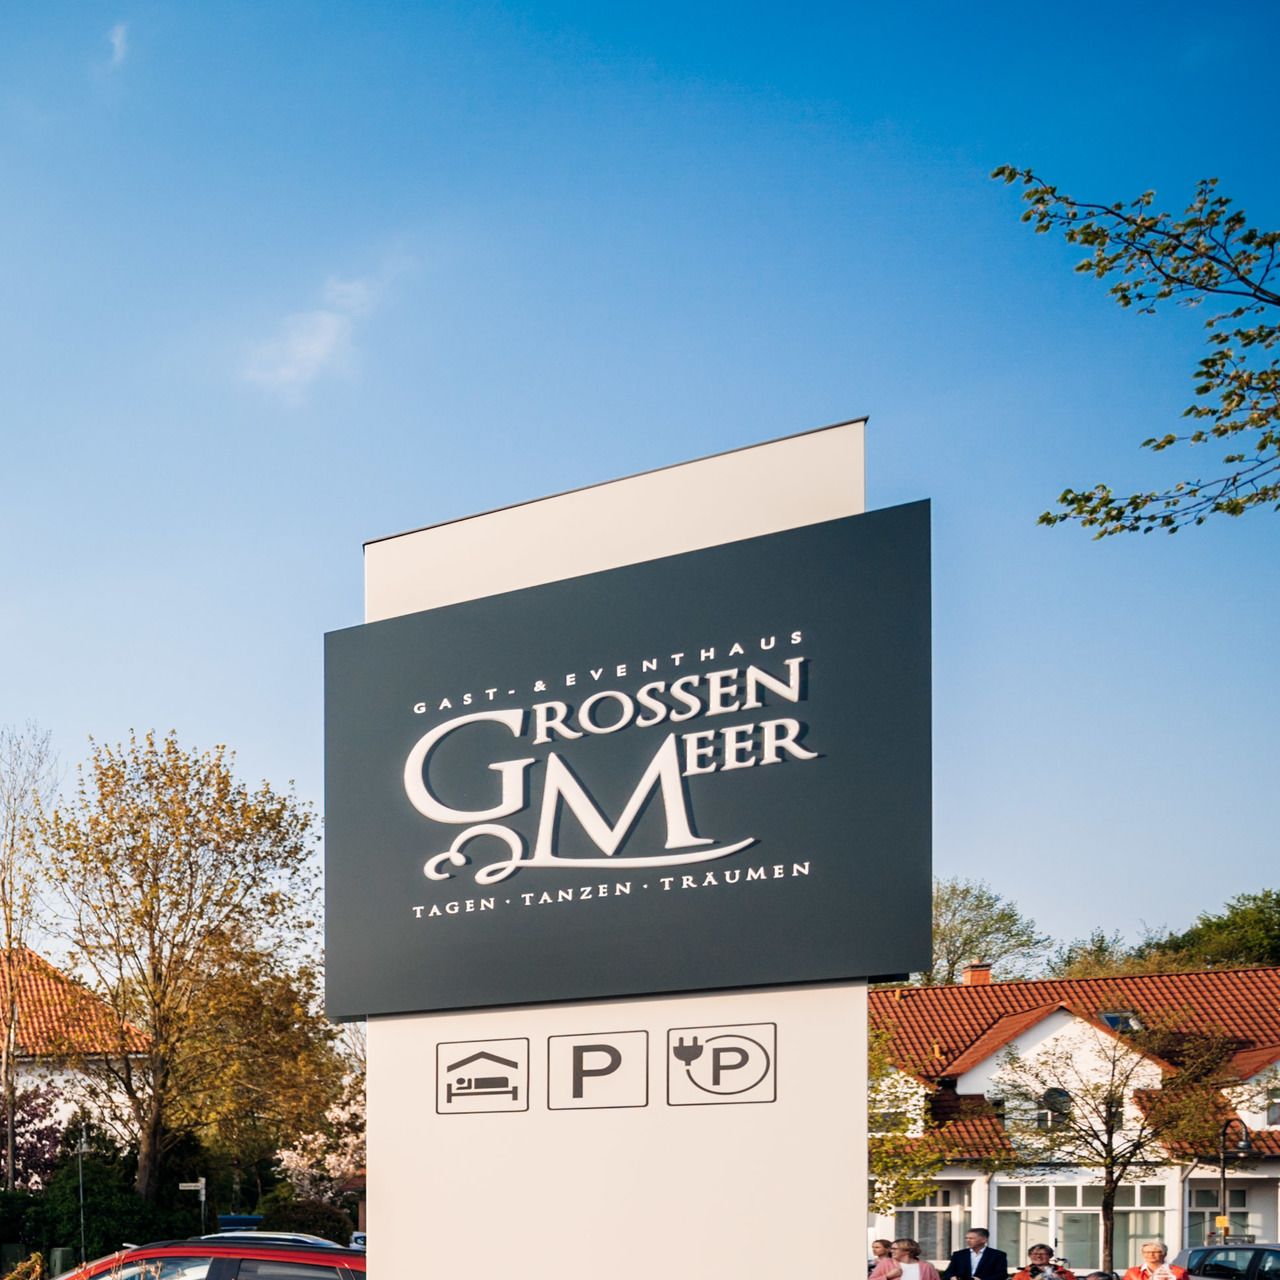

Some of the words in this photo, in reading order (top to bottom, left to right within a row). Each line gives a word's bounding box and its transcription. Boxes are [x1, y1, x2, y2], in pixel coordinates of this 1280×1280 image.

[533, 680, 547, 692] &
[566, 631, 803, 686] EVENTHAUS
[404, 657, 806, 824] GROSSEN
[534, 717, 819, 868] MEER
[413, 897, 495, 919] TAGEN
[521, 882, 632, 906] TANZEN
[660, 862, 811, 891] TRÄUMEN
[572, 1044, 622, 1098] P
[712, 1046, 749, 1086] P
